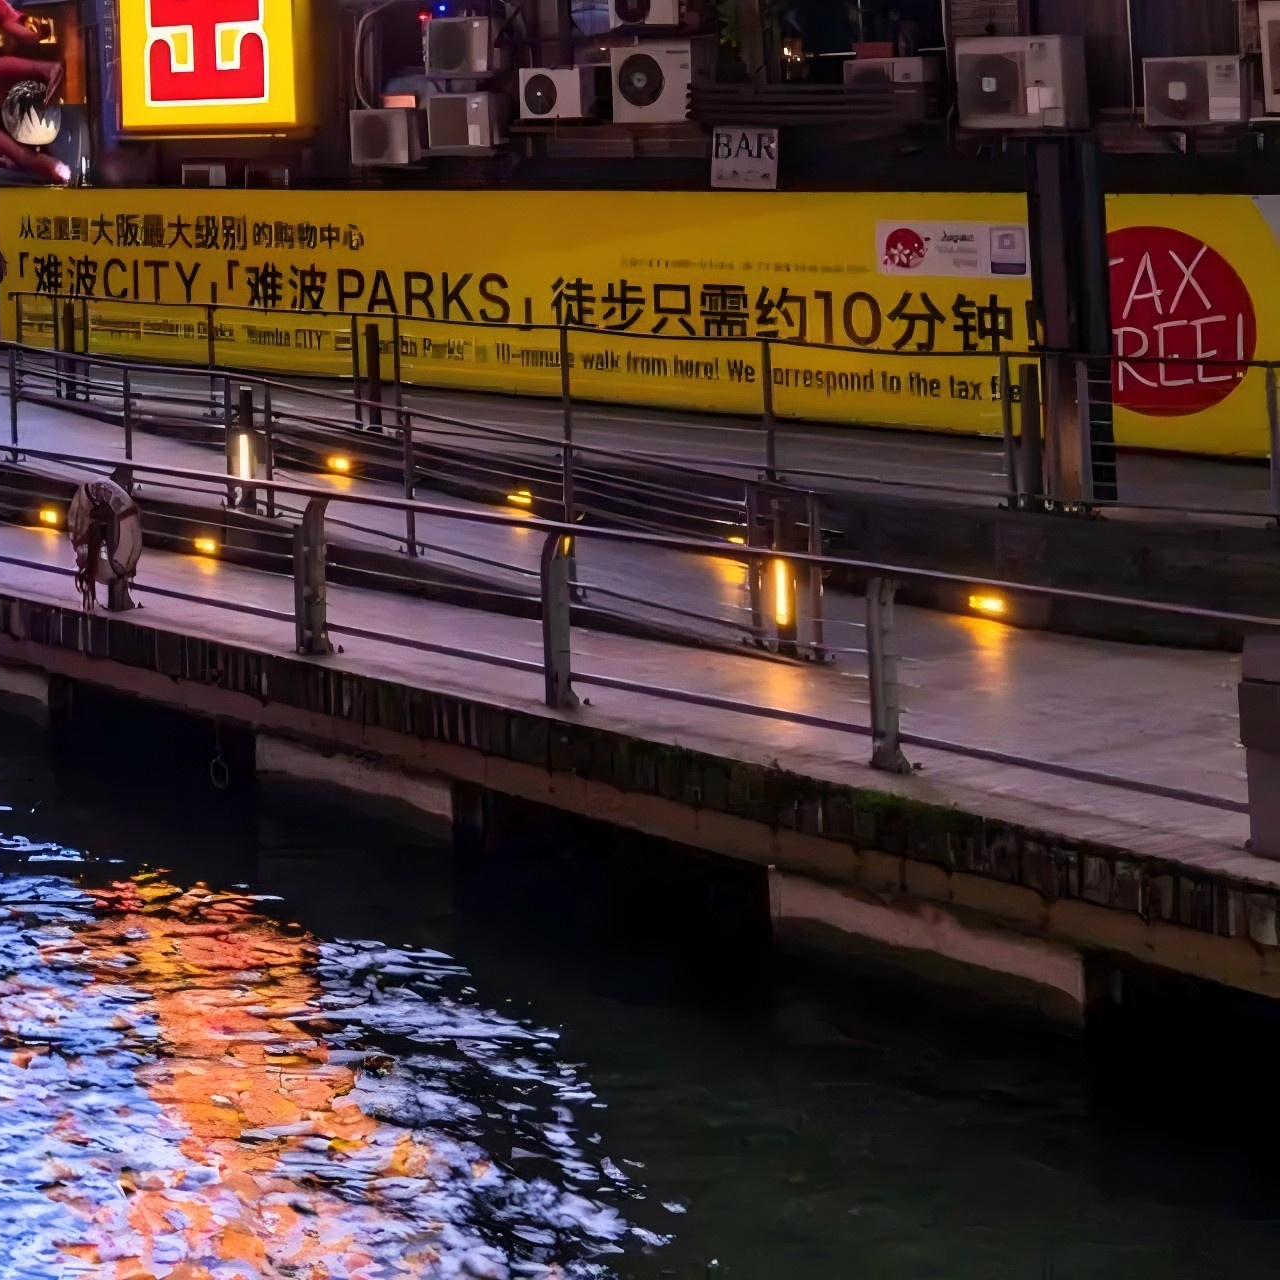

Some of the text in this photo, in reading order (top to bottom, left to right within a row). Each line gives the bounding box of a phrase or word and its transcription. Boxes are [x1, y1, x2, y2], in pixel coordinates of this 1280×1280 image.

[1112, 312, 1244, 392] REE!
[772, 367, 875, 398] orrespond
[909, 371, 941, 398] the
